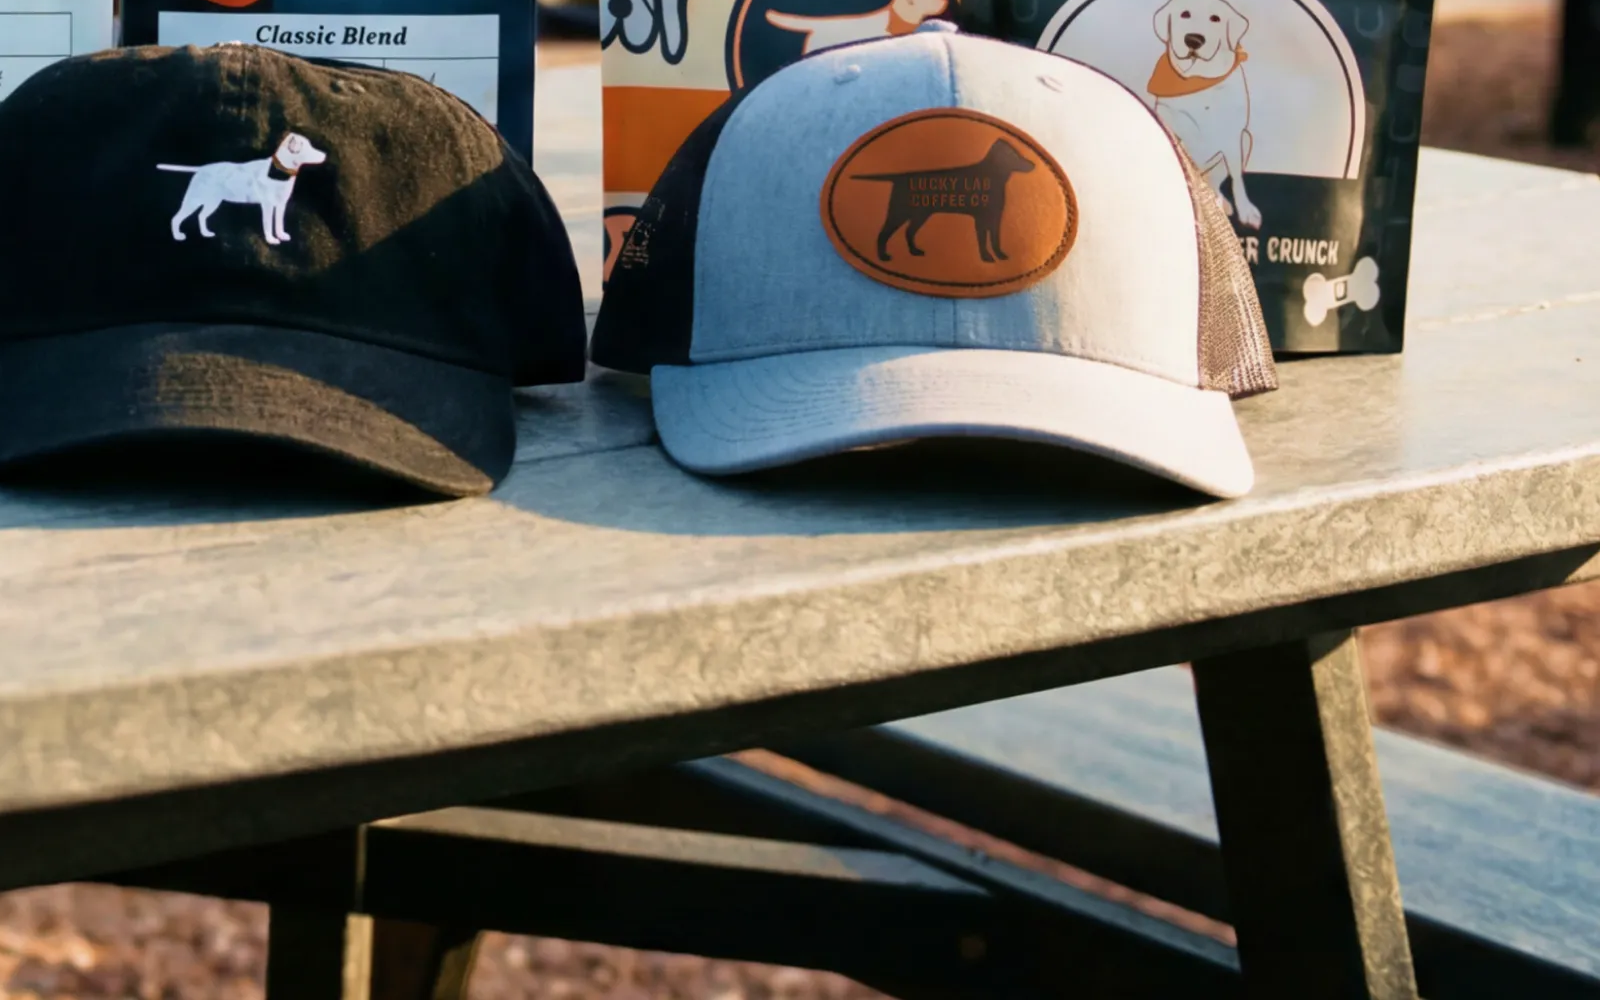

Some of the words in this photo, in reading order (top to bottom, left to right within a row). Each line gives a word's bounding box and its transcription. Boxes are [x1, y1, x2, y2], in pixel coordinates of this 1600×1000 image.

[253, 24, 336, 46] Classic
[341, 26, 407, 46] Blend
[909, 177, 958, 191] LUCKY
[964, 176, 991, 191] LAB
[909, 193, 966, 207] COFFEE
[1268, 237, 1340, 266] CRUNCH
